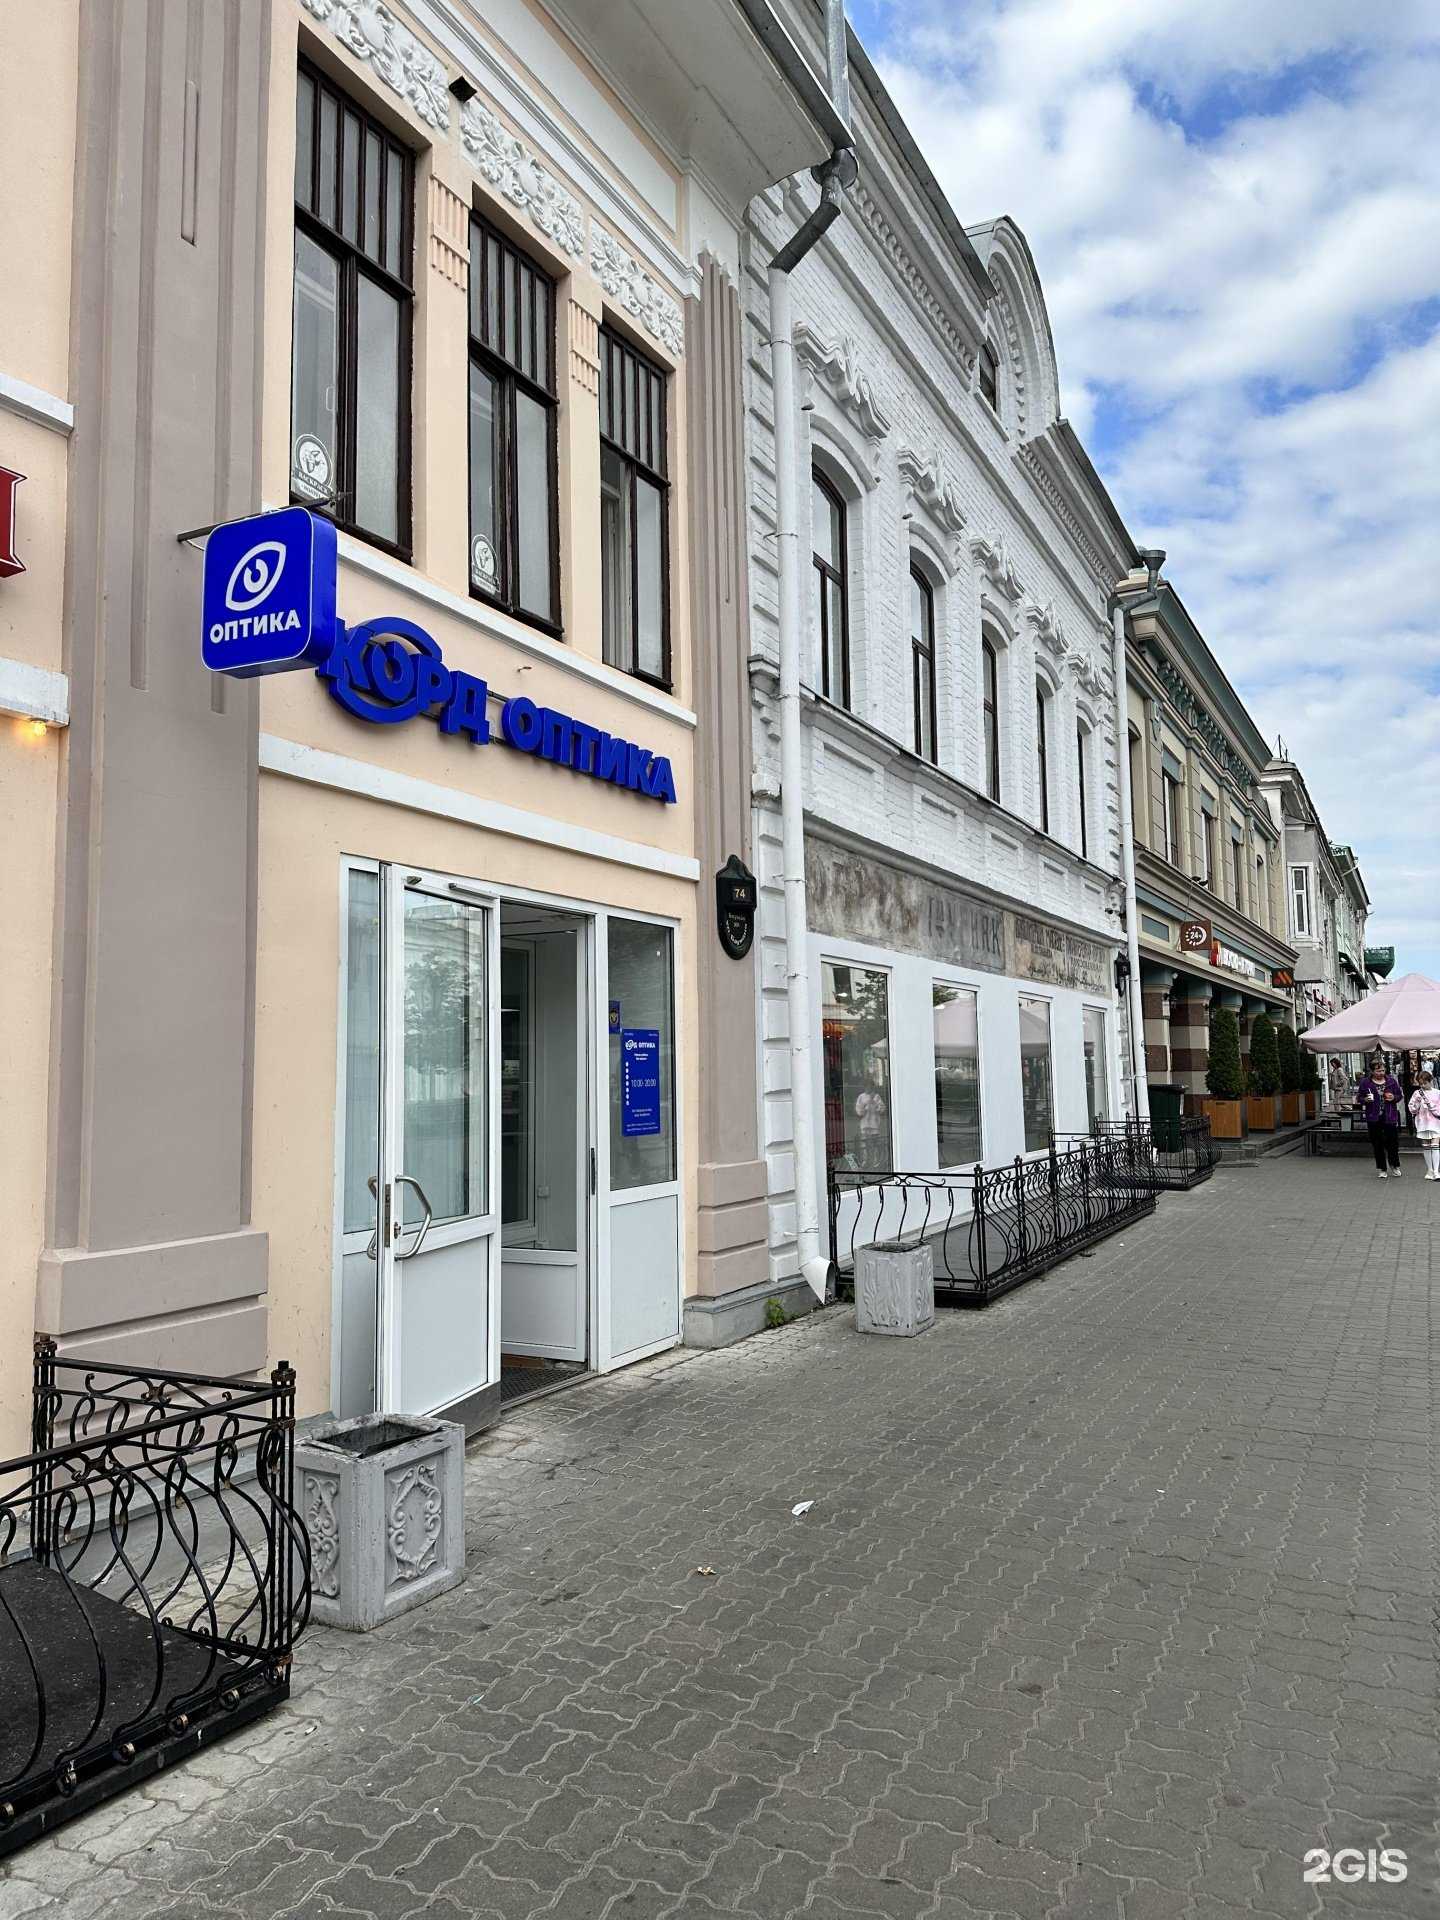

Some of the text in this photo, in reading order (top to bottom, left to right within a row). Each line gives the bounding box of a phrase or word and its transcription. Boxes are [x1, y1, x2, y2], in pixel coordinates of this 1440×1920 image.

[210, 609, 301, 644] ОПТИКА
[315, 616, 677, 804] КОРД ОПТИКА
[734, 888, 746, 898] 74
[638, 1041, 656, 1049] ОПТИКА
